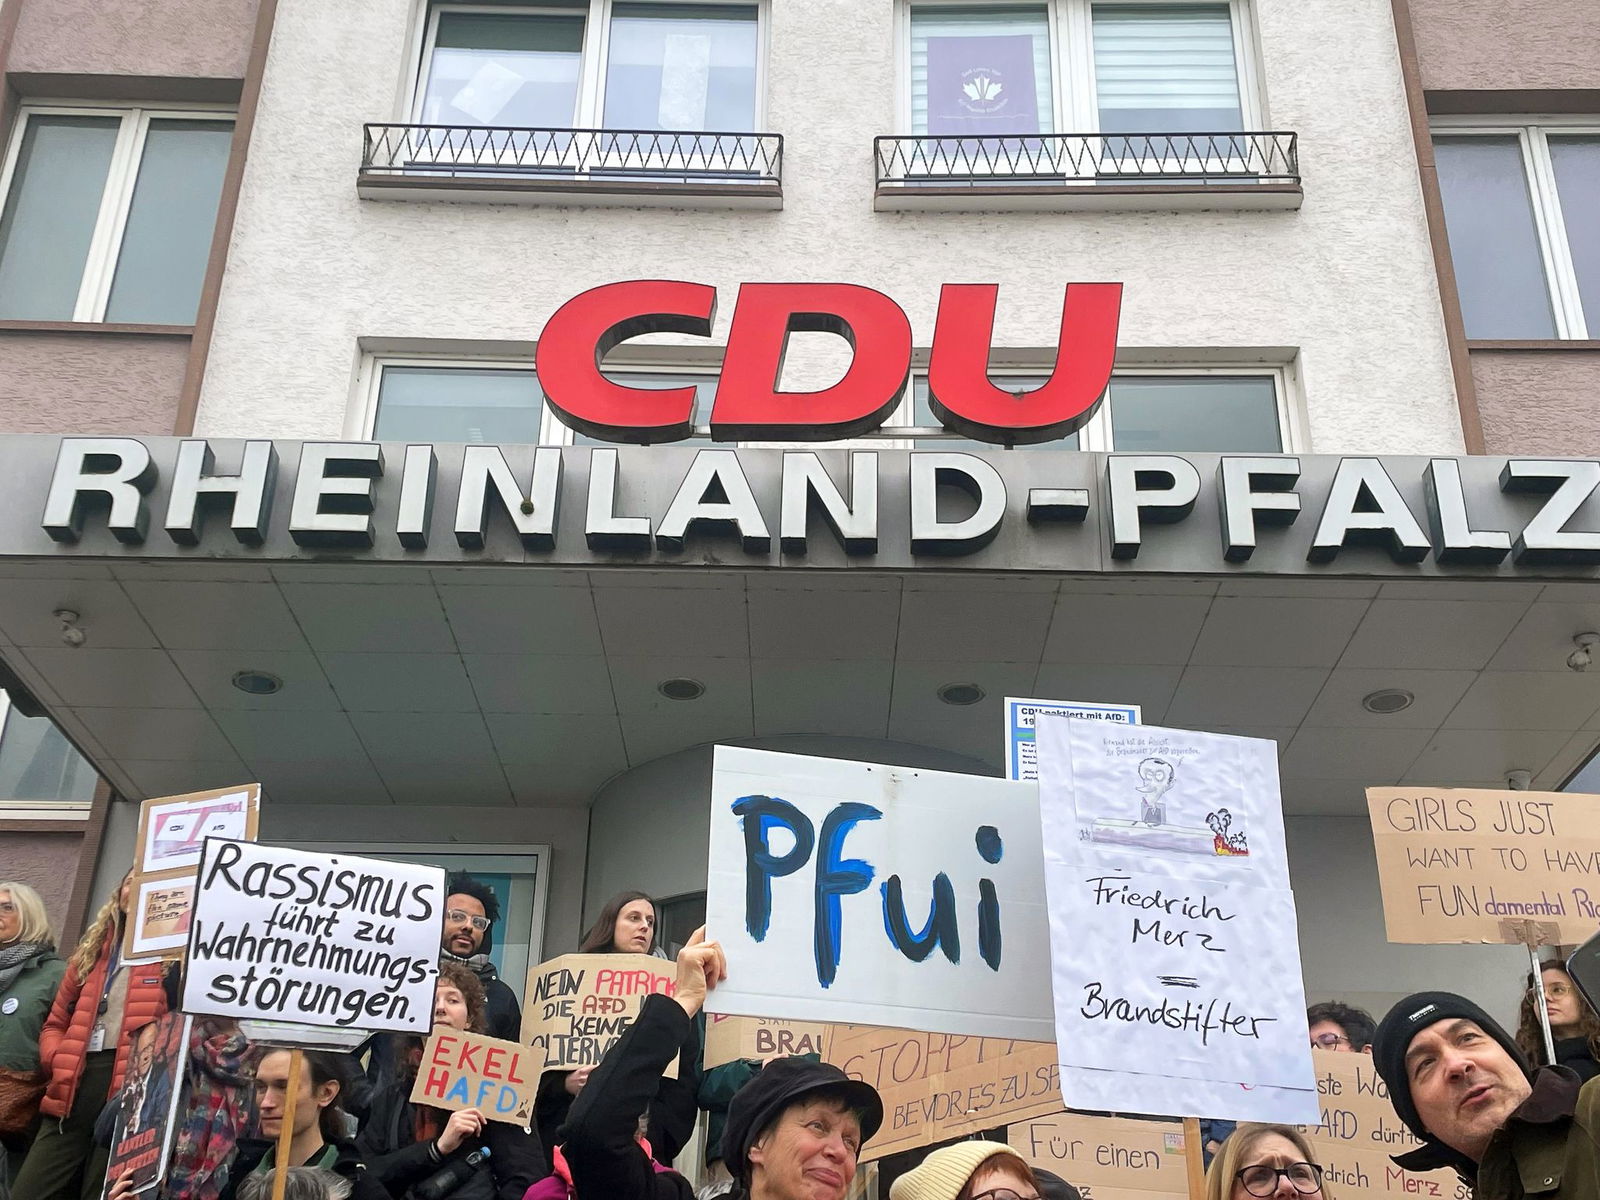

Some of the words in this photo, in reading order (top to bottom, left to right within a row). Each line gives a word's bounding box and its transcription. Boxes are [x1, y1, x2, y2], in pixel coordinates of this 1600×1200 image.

[536, 280, 1123, 443] CDU
[41, 437, 1600, 562] RHEINLAND-PFALZ
[1023, 717, 1035, 725] 19
[1086, 712, 1102, 720] mit
[1105, 711, 1126, 721] AfD:
[1387, 797, 1477, 832] GIRLS
[1493, 801, 1555, 836] JUST
[1406, 847, 1475, 870] WANT
[1491, 847, 1528, 872] TO
[203, 842, 434, 922] Rassismus
[1086, 876, 1236, 921] Friedrich
[263, 902, 340, 937] führt
[354, 920, 395, 945] zu
[1132, 918, 1226, 952] Merz
[192, 919, 439, 993] Wahrnehmungs-
[206, 966, 416, 1026] störungen.
[533, 969, 585, 1005] NEIN
[542, 999, 575, 1021] DIE
[1081, 982, 1278, 1046] Brandstifter
[432, 1035, 524, 1084] EKEL
[424, 1066, 518, 1113] HAFD
[1317, 1073, 1343, 1097] ste
[1315, 1107, 1358, 1140] AfD
[1030, 1123, 1083, 1160] Für
[1096, 1143, 1160, 1170] einen
[1321, 1162, 1369, 1188] drich
[1386, 1166, 1442, 1196] Merz
